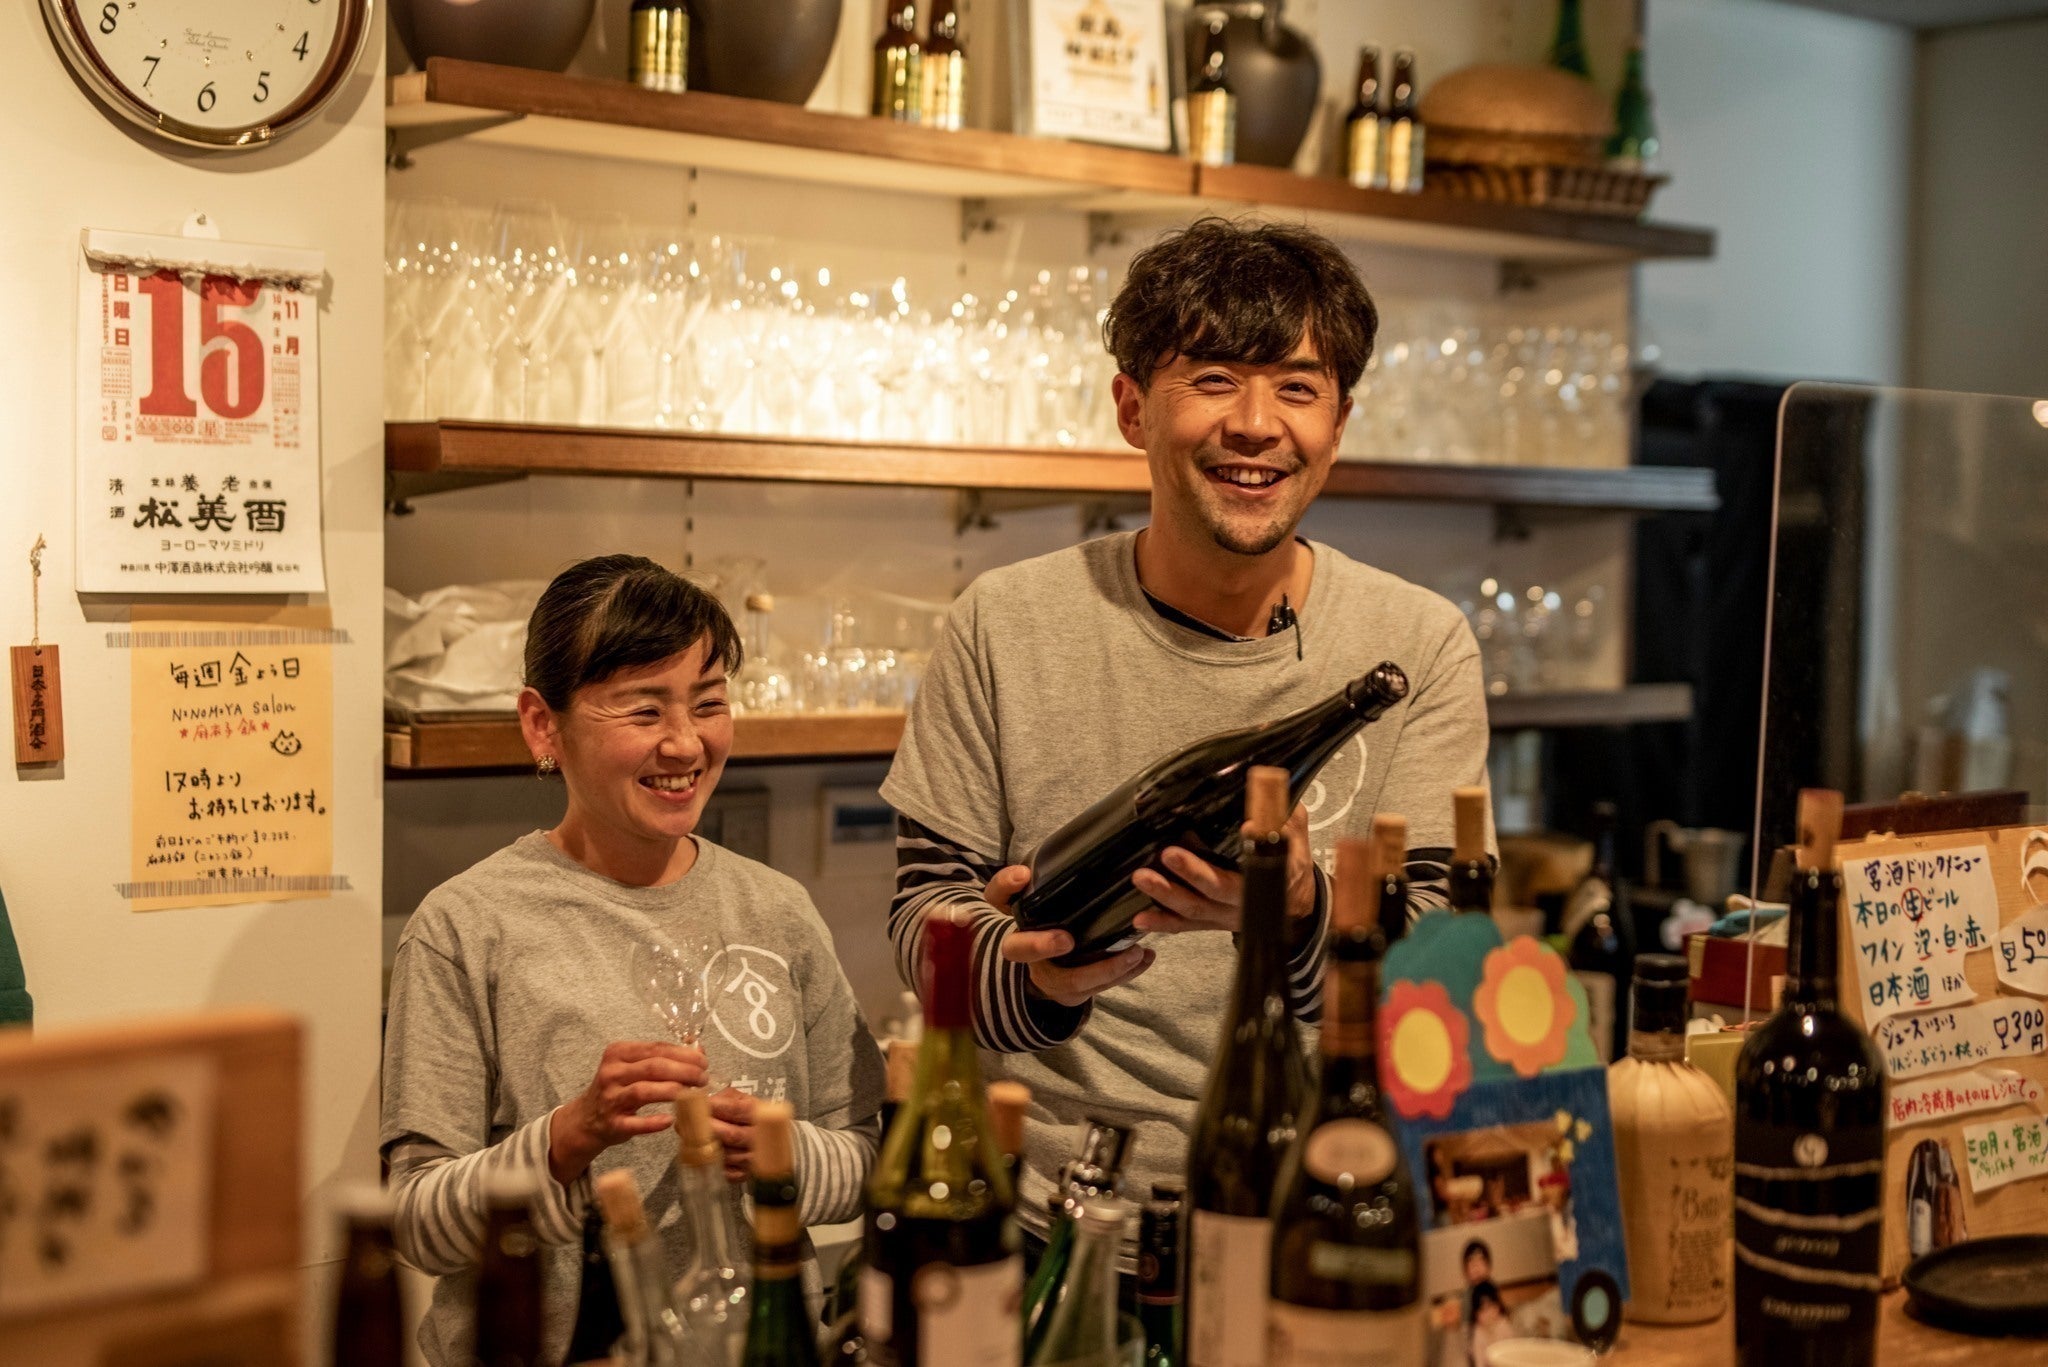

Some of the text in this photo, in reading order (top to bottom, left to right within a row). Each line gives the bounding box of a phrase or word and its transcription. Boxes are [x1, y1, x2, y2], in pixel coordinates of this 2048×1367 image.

[100, 2, 119, 34] 8
[293, 31, 309, 61] 4
[143, 55, 160, 87] 7
[253, 71, 269, 103] 5
[197, 81, 216, 112] 6
[138, 269, 264, 419] 15
[181, 474, 240, 492] 養老
[160, 540, 264, 551] ヨーローマツミドリ
[165, 767, 241, 792] 17時より
[188, 788, 326, 820] お待ちしております。
[1861, 938, 1904, 966] ワイン
[1869, 966, 1930, 1006] 日本酒
[2011, 1008, 2044, 1042] 300
